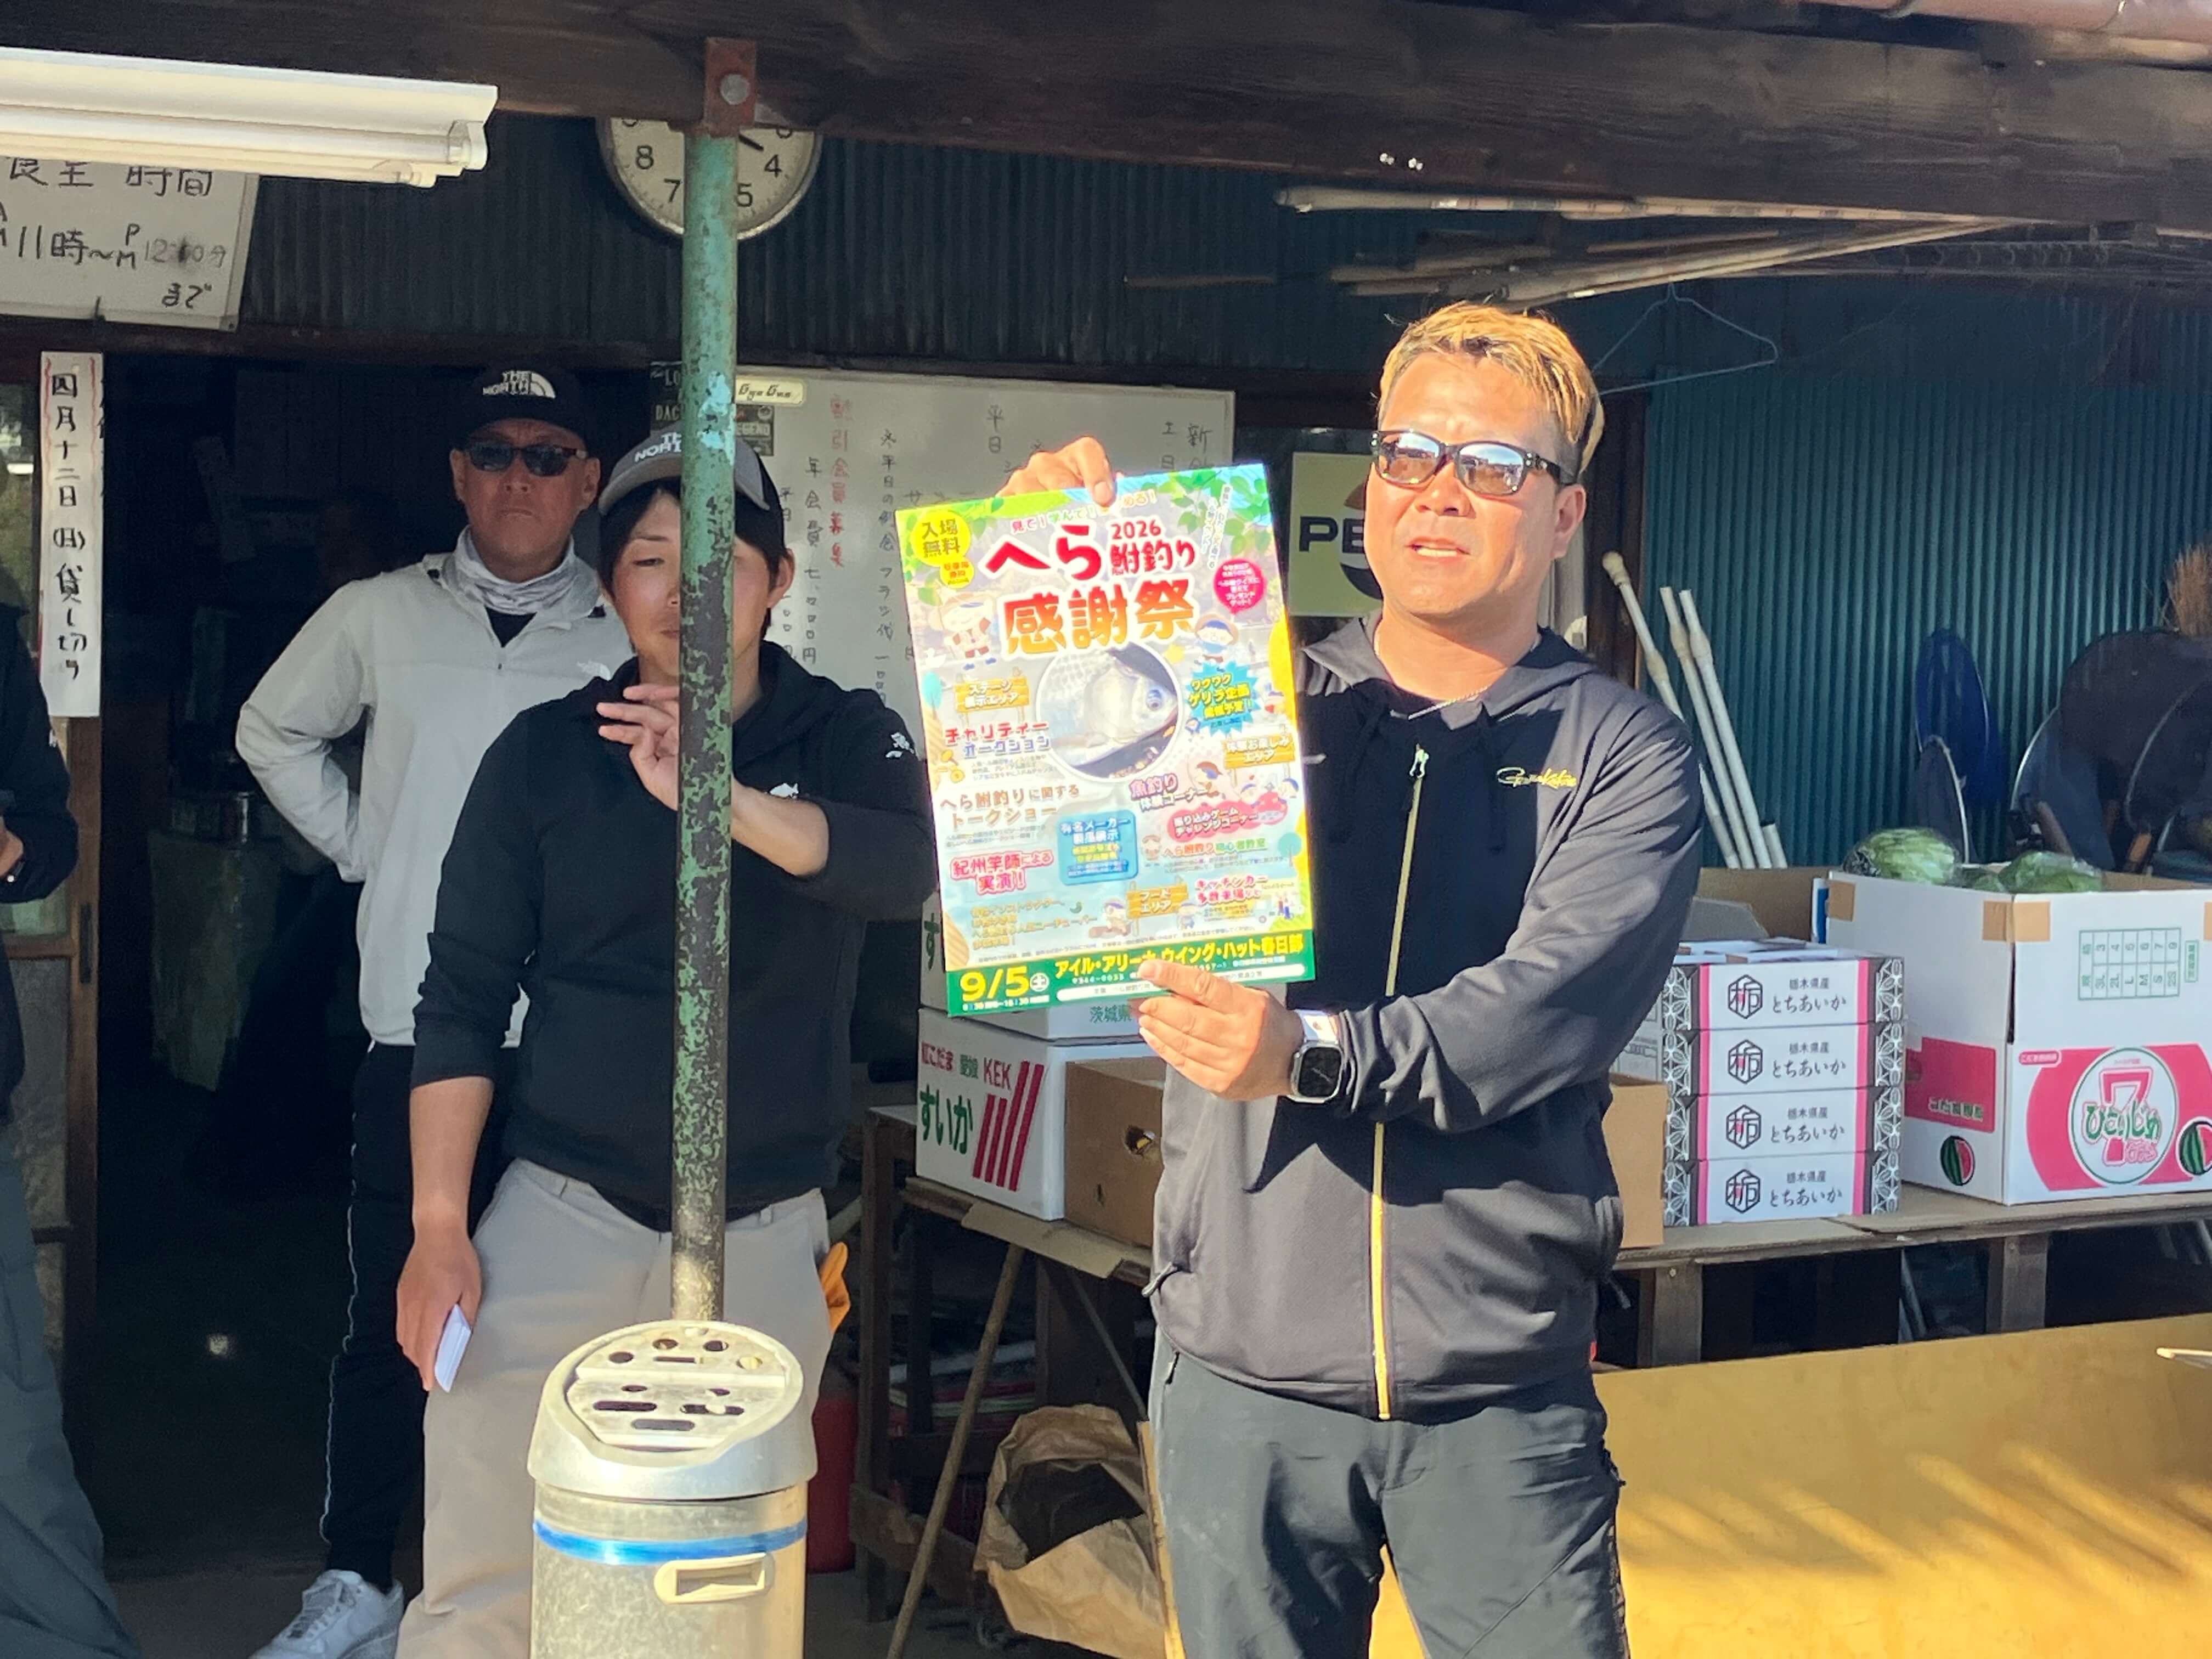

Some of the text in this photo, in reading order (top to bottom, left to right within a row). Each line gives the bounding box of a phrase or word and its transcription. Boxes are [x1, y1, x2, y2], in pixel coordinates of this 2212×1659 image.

[636, 145, 654, 170] 8
[764, 155, 782, 177] 4
[664, 178, 682, 202] 7
[736, 183, 753, 207] 5
[987, 405, 1005, 454] 平日
[922, 519, 958, 539] 入場
[1111, 519, 1162, 540] 2026
[923, 536, 960, 558] 無料
[985, 524, 1102, 580] へら
[1005, 579, 1194, 654] 感謝祭
[1192, 673, 1232, 691] ワクワク
[945, 722, 1048, 745] チャリティー
[964, 736, 1049, 759] オークション
[953, 806, 1057, 830] トークショー
[960, 966, 1029, 1002] 9/5
[2140, 974, 2148, 986] M
[2153, 975, 2163, 983] S
[1772, 994, 1847, 1013] とちあいか
[983, 1057, 1012, 1091] KEK
[1772, 1059, 1847, 1078] とちあいか
[919, 1084, 974, 1155] すいか
[1770, 1124, 1846, 1143] とちあいか
[1769, 1187, 1843, 1207] とちあいか
